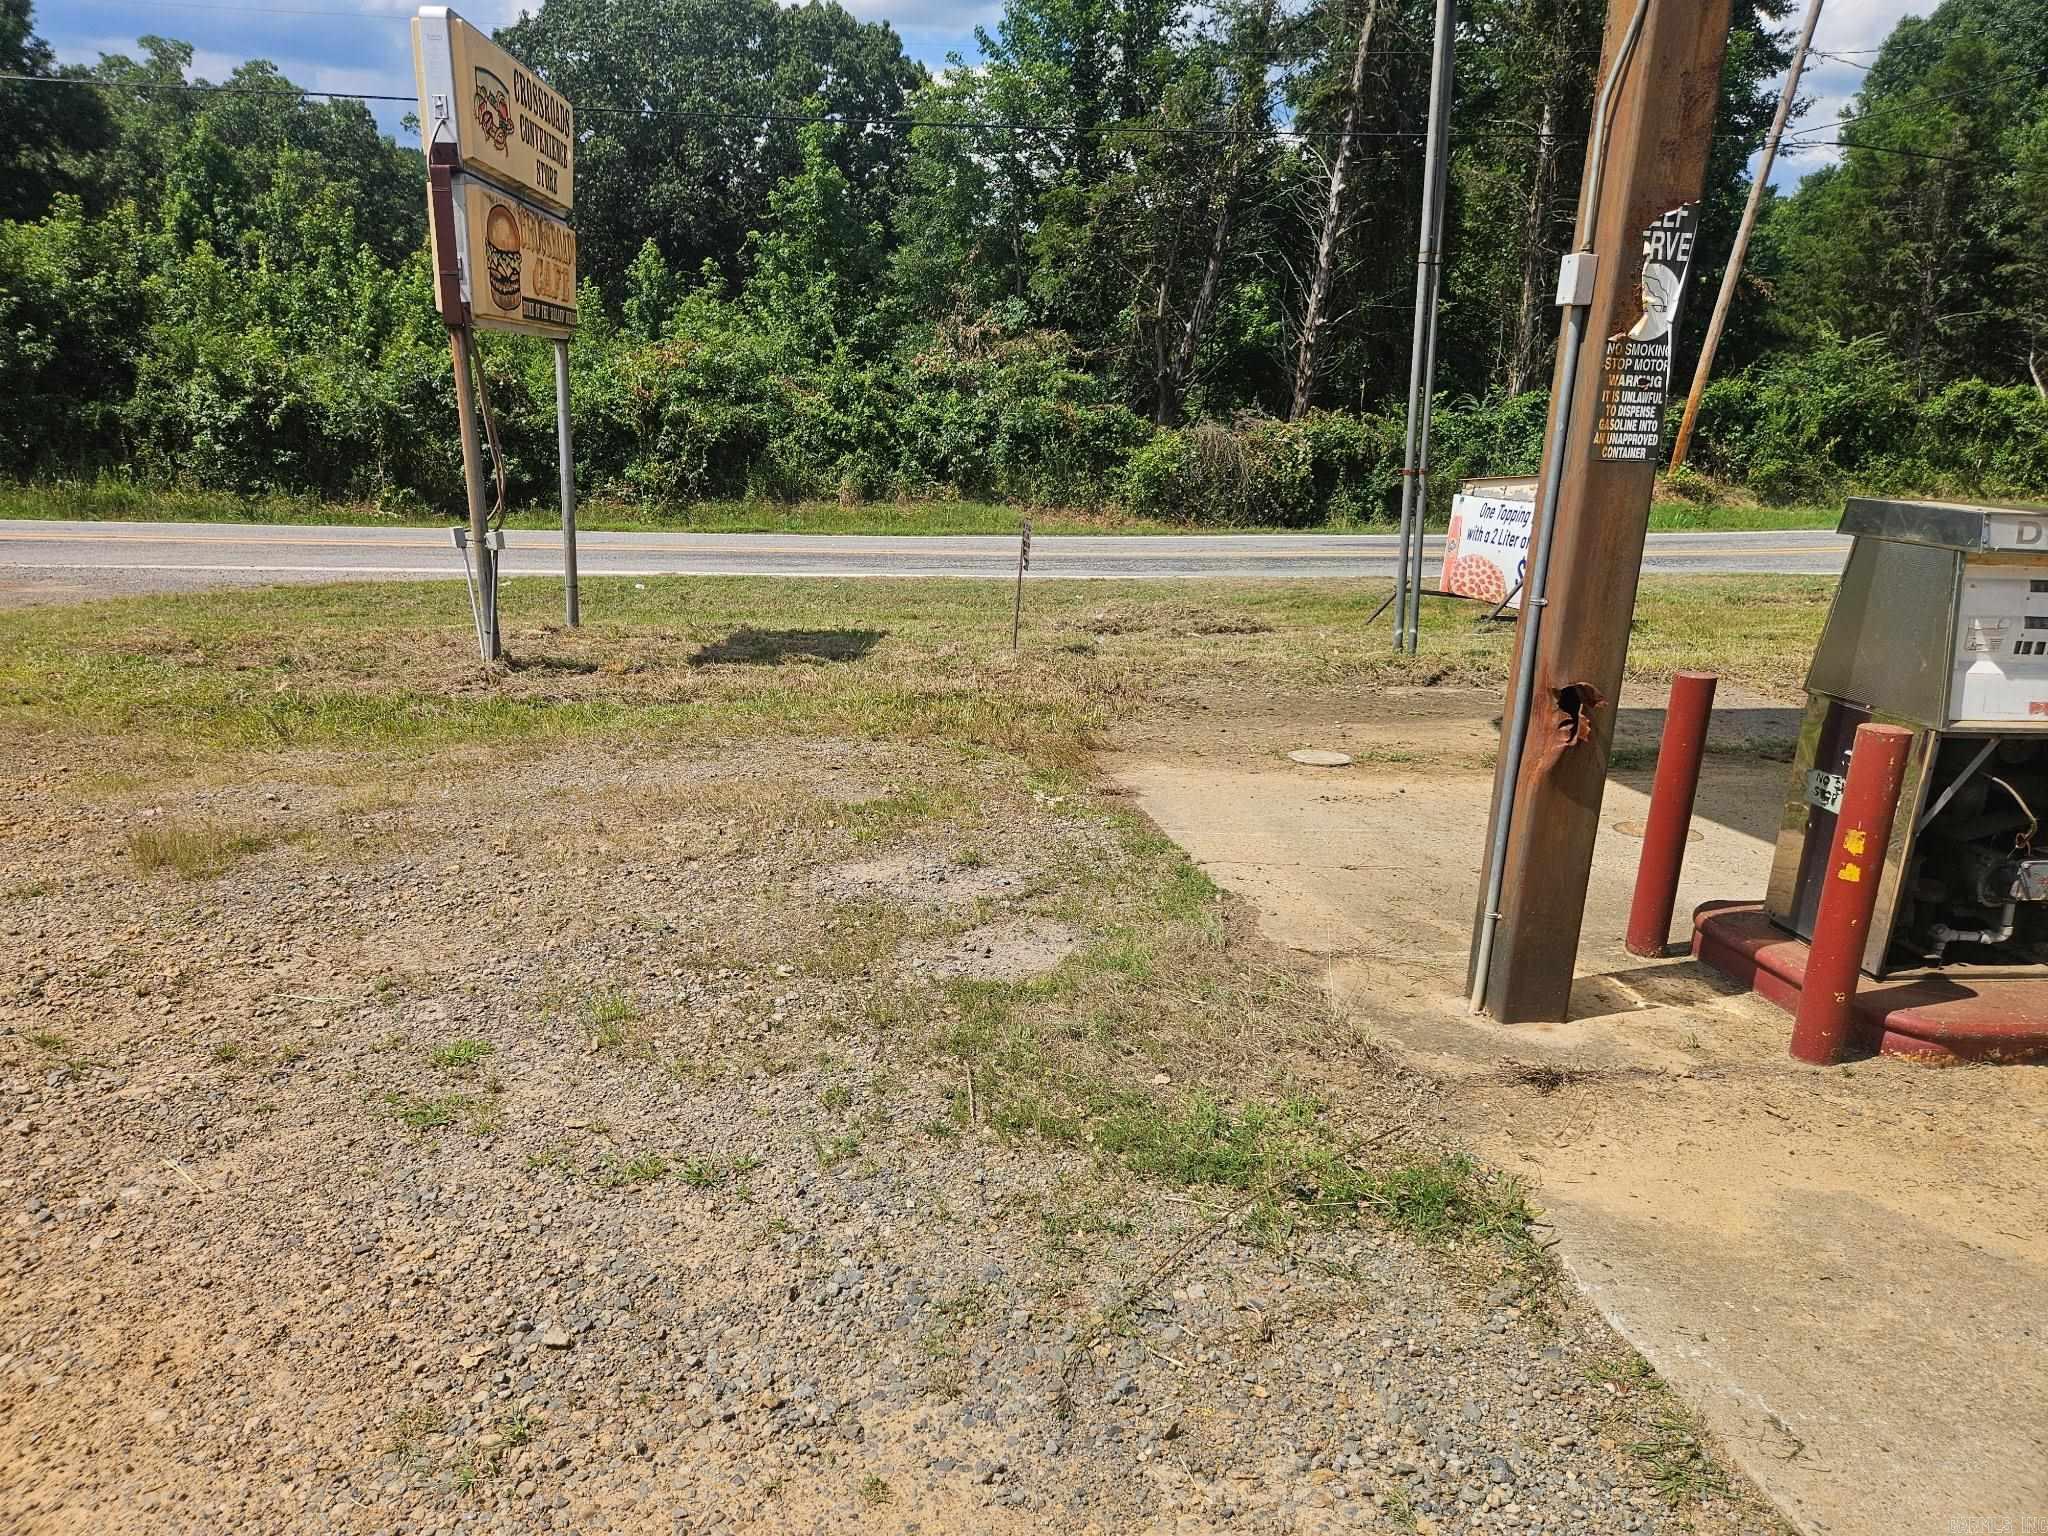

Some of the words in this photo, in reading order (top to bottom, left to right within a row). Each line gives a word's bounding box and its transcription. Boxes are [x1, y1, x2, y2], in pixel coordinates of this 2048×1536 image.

[514, 68, 570, 138] CROSSROADS
[520, 113, 568, 169] CONVENIENCE
[536, 159, 557, 194] STORE
[1607, 342, 1623, 356] NO
[1604, 357, 1633, 370] STOP
[1608, 374, 1663, 388] WARNNG
[1601, 390, 1611, 402] IT
[1611, 390, 1620, 402] IS
[1621, 391, 1663, 404] UNLAWFUL
[1606, 405, 1616, 417] TO
[1617, 405, 1656, 418] DISPENSE
[1599, 418, 1639, 431] GASOLINE
[1639, 420, 1658, 432] INTO
[1593, 432, 1605, 444] AN
[1606, 432, 1658, 445] UNAPPROVED
[1601, 446, 1646, 459] CONTAINER
[1479, 502, 1496, 519] One
[1497, 504, 1531, 528] Topping
[1467, 525, 1484, 542] with
[1483, 531, 1491, 543] a
[1491, 528, 1499, 544] 2
[1498, 529, 1520, 548] Liter
